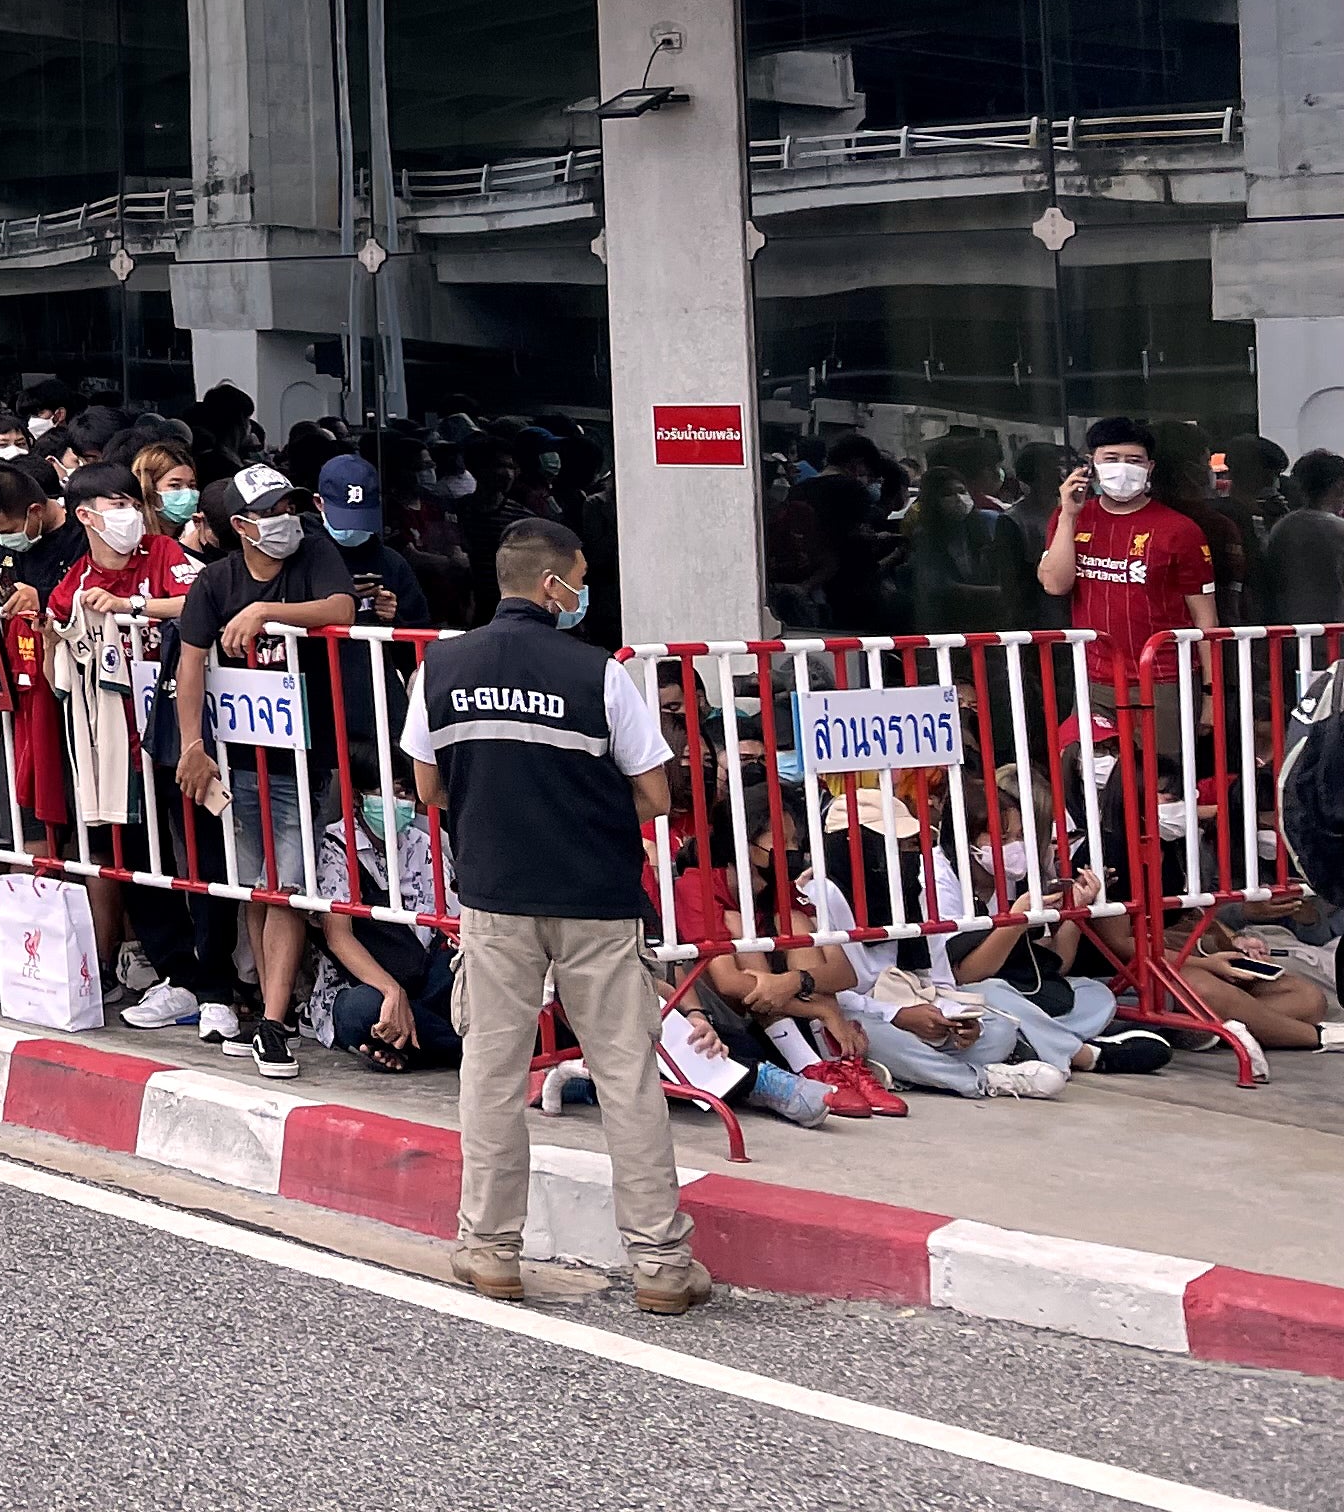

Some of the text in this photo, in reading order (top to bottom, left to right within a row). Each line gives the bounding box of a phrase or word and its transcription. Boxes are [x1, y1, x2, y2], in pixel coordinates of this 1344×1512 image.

[656, 424, 741, 441] หัวรับน้ำดับเพลิง
[451, 687, 565, 719] G-GUARD
[814, 697, 953, 760] ส่วนจราจร
[22, 967, 41, 981] LFC
